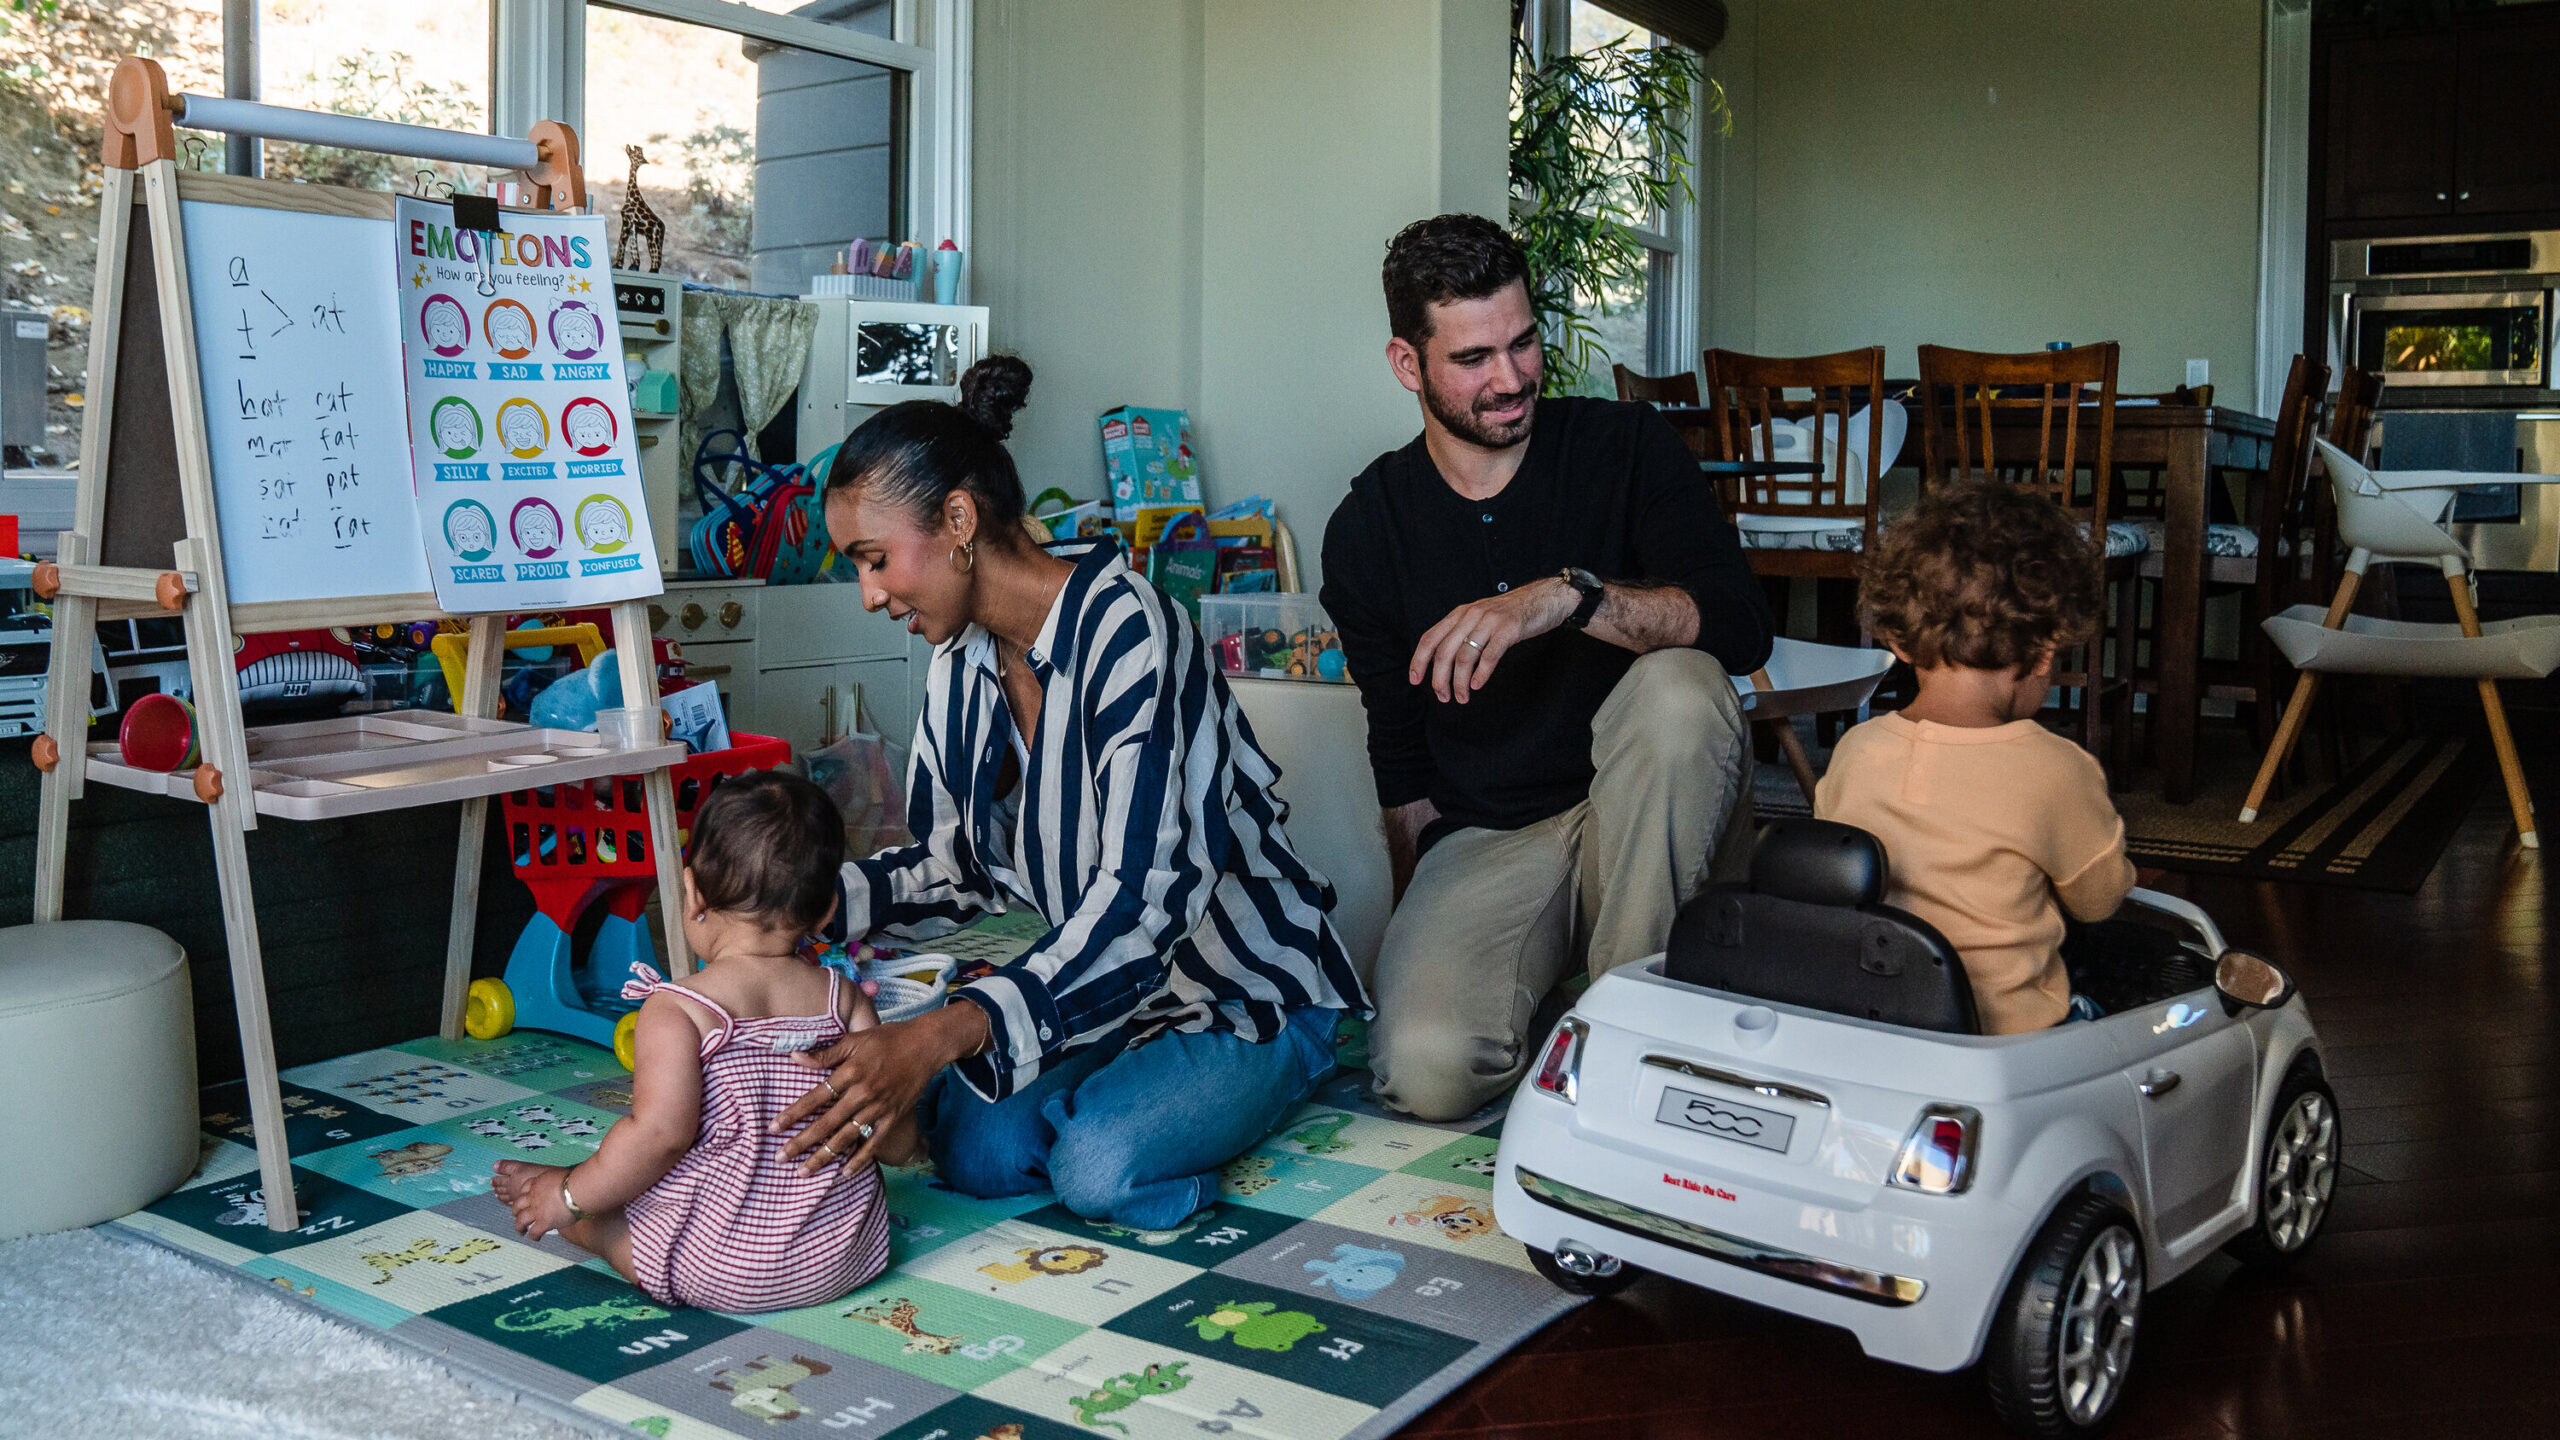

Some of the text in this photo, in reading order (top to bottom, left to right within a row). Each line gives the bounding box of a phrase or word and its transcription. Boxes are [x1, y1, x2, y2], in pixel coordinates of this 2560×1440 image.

[410, 219, 592, 269] EMOTIONS
[229, 256, 249, 282] a
[436, 266, 565, 292] How are you feeling?
[428, 362, 470, 377] HAPPY
[502, 365, 528, 379] SAD
[558, 365, 604, 379] ANGRY
[320, 422, 359, 451] fat
[326, 464, 360, 499] pat
[443, 465, 479, 479] SILLY
[507, 466, 549, 477] EXCITED
[571, 464, 619, 475] WORRIED
[455, 567, 500, 581] SCARED
[520, 564, 563, 578] PROUD
[584, 558, 636, 572] CONFUSED
[1165, 557, 1201, 580] Animals
[1684, 1100, 1763, 1136] 500
[1663, 1173, 1737, 1202] Best Ride On Cars
[617, 1329, 690, 1356] Nn
[959, 1335, 1025, 1362] Gg
[1317, 1337, 1366, 1361] Ff
[820, 1395, 896, 1431] Hh
